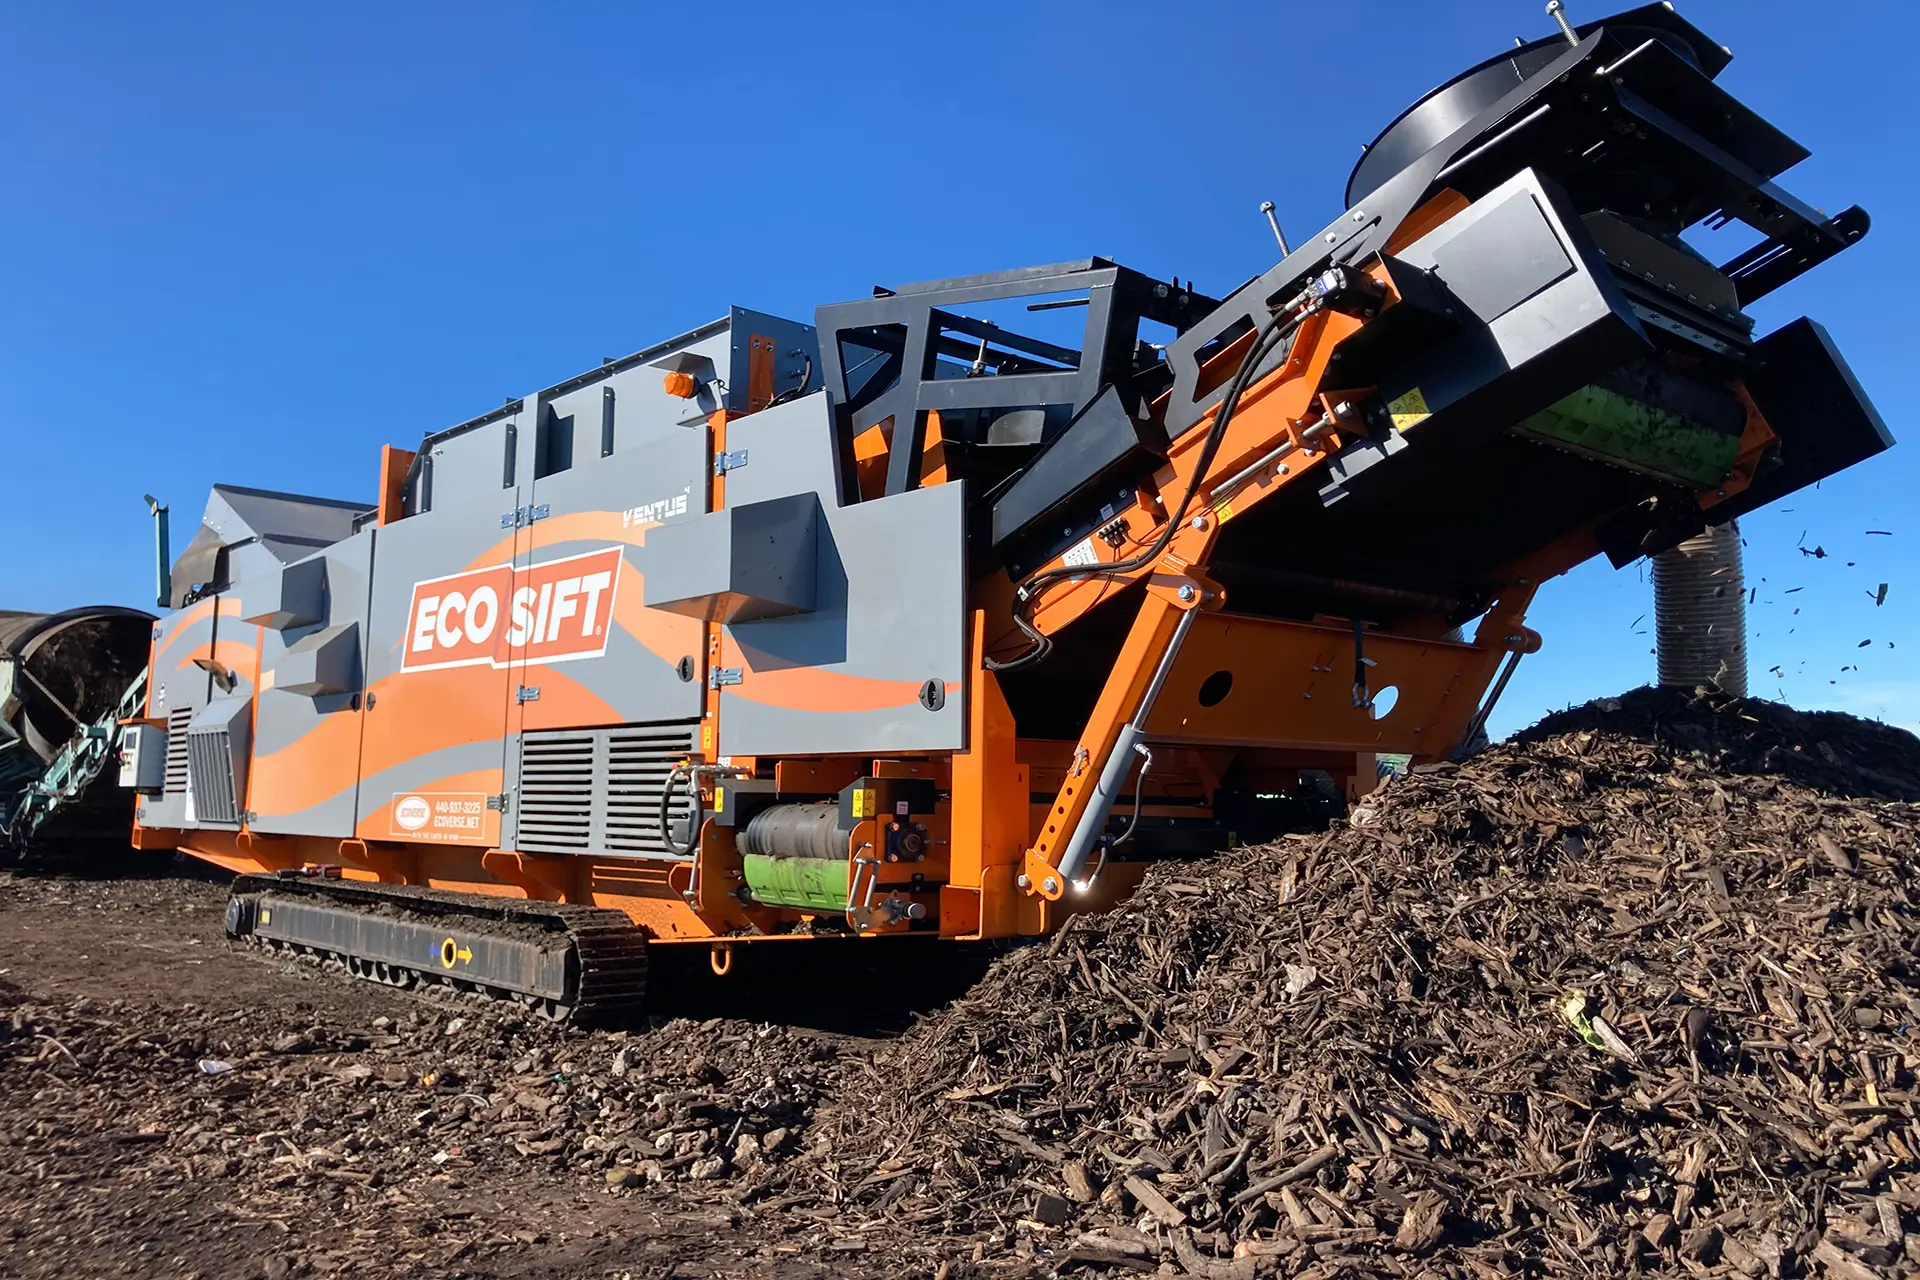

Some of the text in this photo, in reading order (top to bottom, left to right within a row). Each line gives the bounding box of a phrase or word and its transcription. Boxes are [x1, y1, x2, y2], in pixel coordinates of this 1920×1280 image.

[412, 571, 611, 652] ECO SIFT
[434, 815, 480, 828] ECOVERSE.NET
